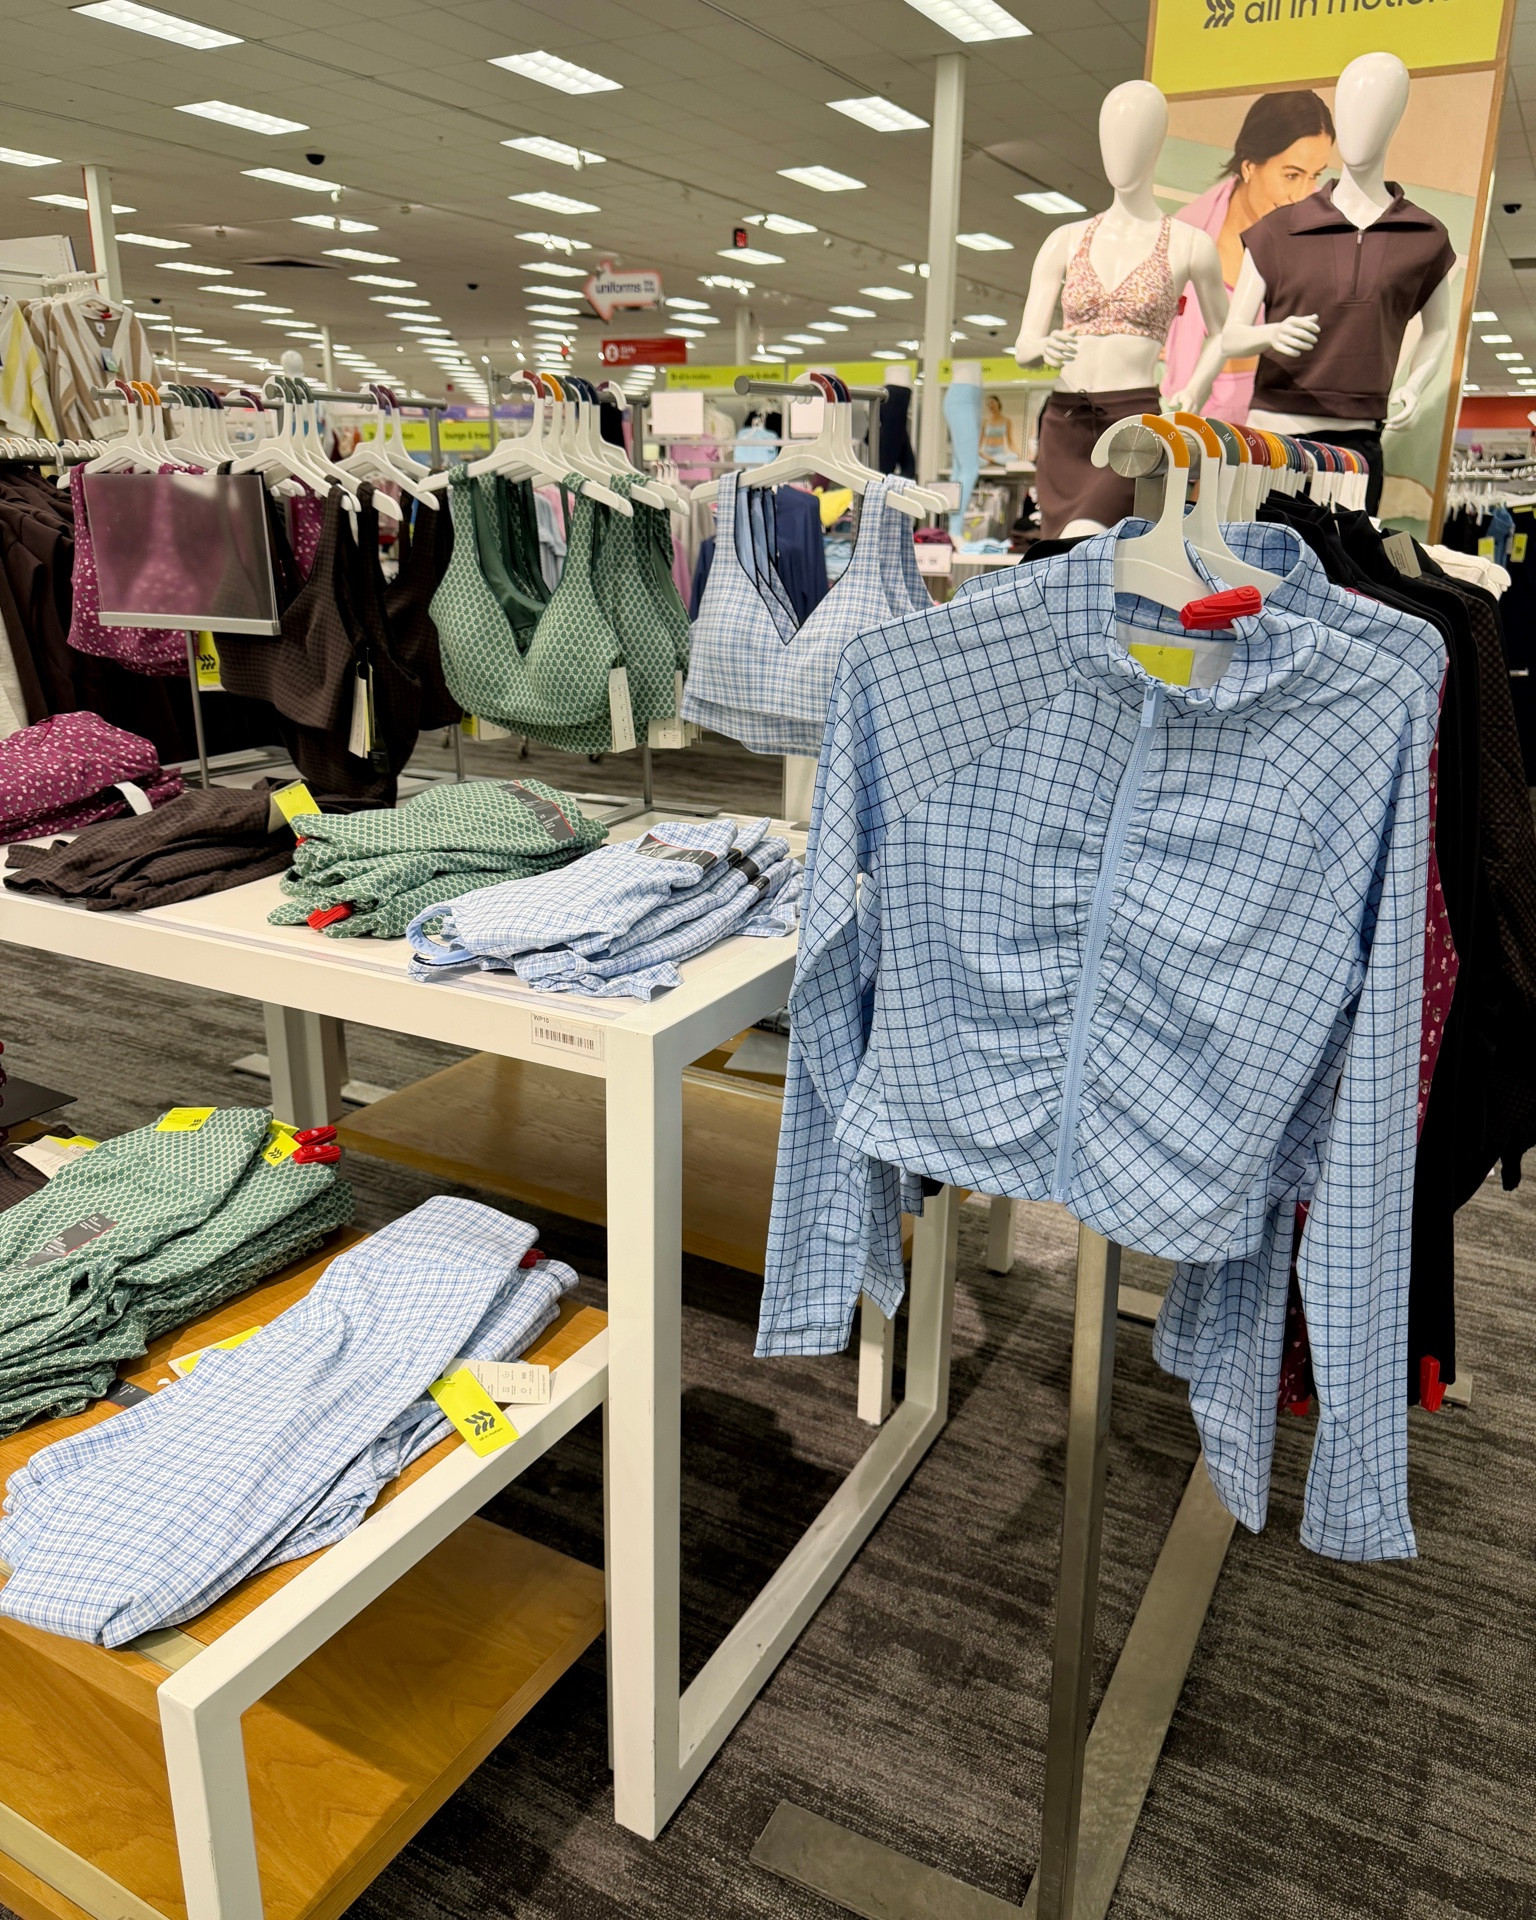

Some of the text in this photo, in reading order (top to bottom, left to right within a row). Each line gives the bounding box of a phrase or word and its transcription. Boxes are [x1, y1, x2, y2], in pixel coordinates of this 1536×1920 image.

[1244, 0, 1281, 24] all
[1289, 0, 1318, 19] in
[595, 281, 641, 294] uniforms
[1167, 431, 1176, 440] S
[1200, 426, 1207, 434] S
[1222, 432, 1232, 443] M
[1246, 434, 1257, 447] XS
[532, 1014, 550, 1024] WP10
